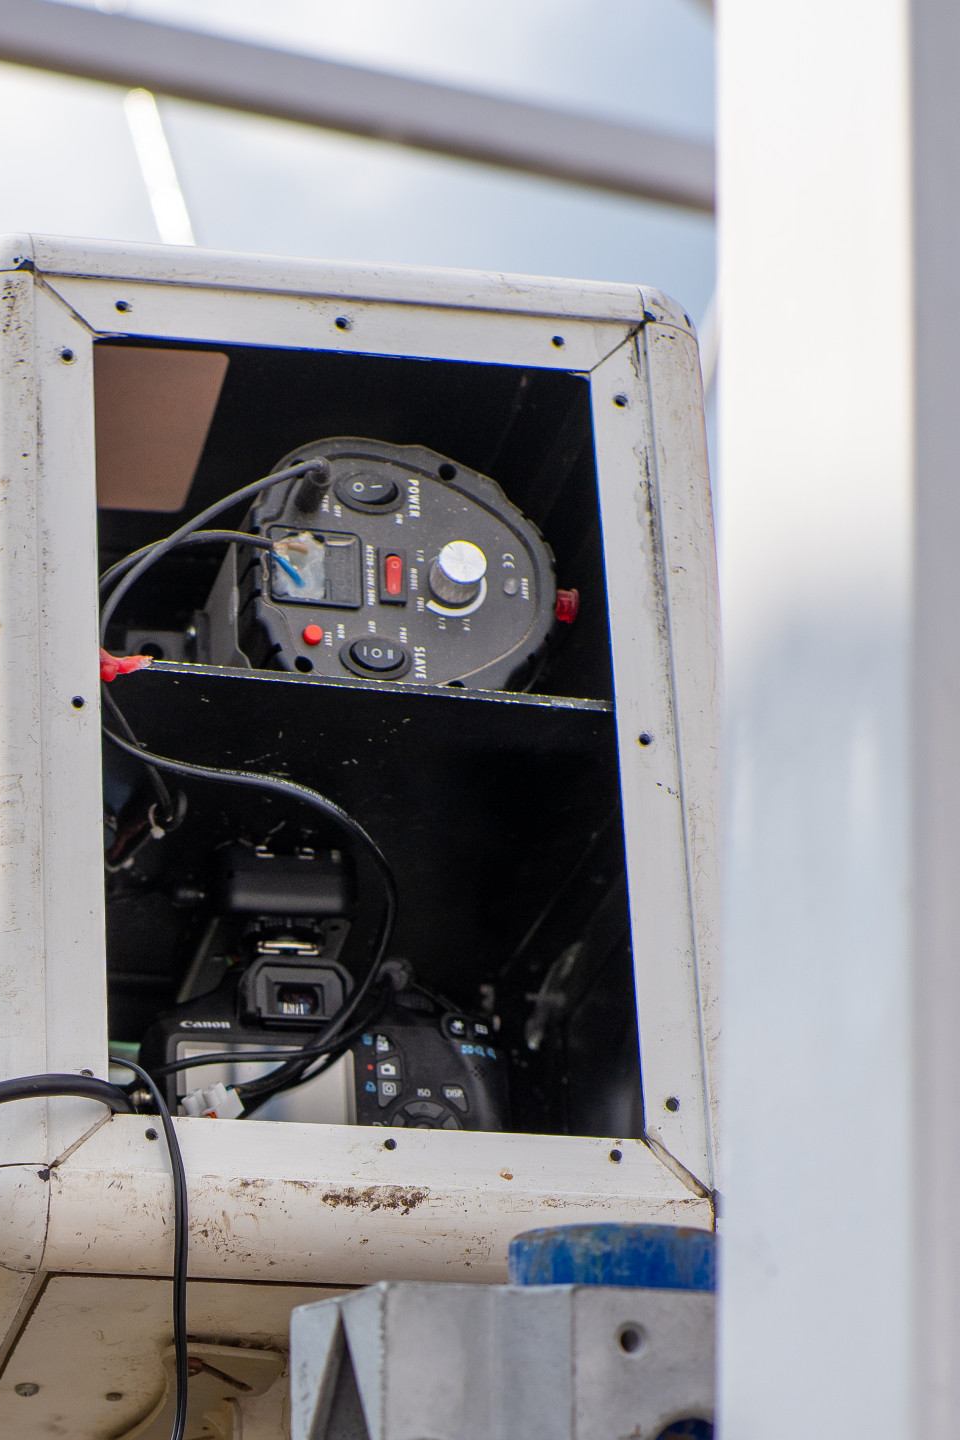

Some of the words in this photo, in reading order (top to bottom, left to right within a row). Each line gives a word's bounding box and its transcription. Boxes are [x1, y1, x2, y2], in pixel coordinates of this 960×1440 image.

[408, 479, 421, 518] POWER
[333, 504, 341, 518] OFF
[395, 513, 403, 526] ON
[502, 553, 515, 569] CE
[410, 567, 418, 591] MODEL
[521, 577, 530, 601] READY
[416, 596, 425, 612] FULL
[368, 620, 376, 634] OFF
[324, 631, 333, 647] TEST
[413, 646, 427, 679] SLAVE
[179, 1019, 231, 1030] Canon
[416, 1088, 431, 1097] ISO
